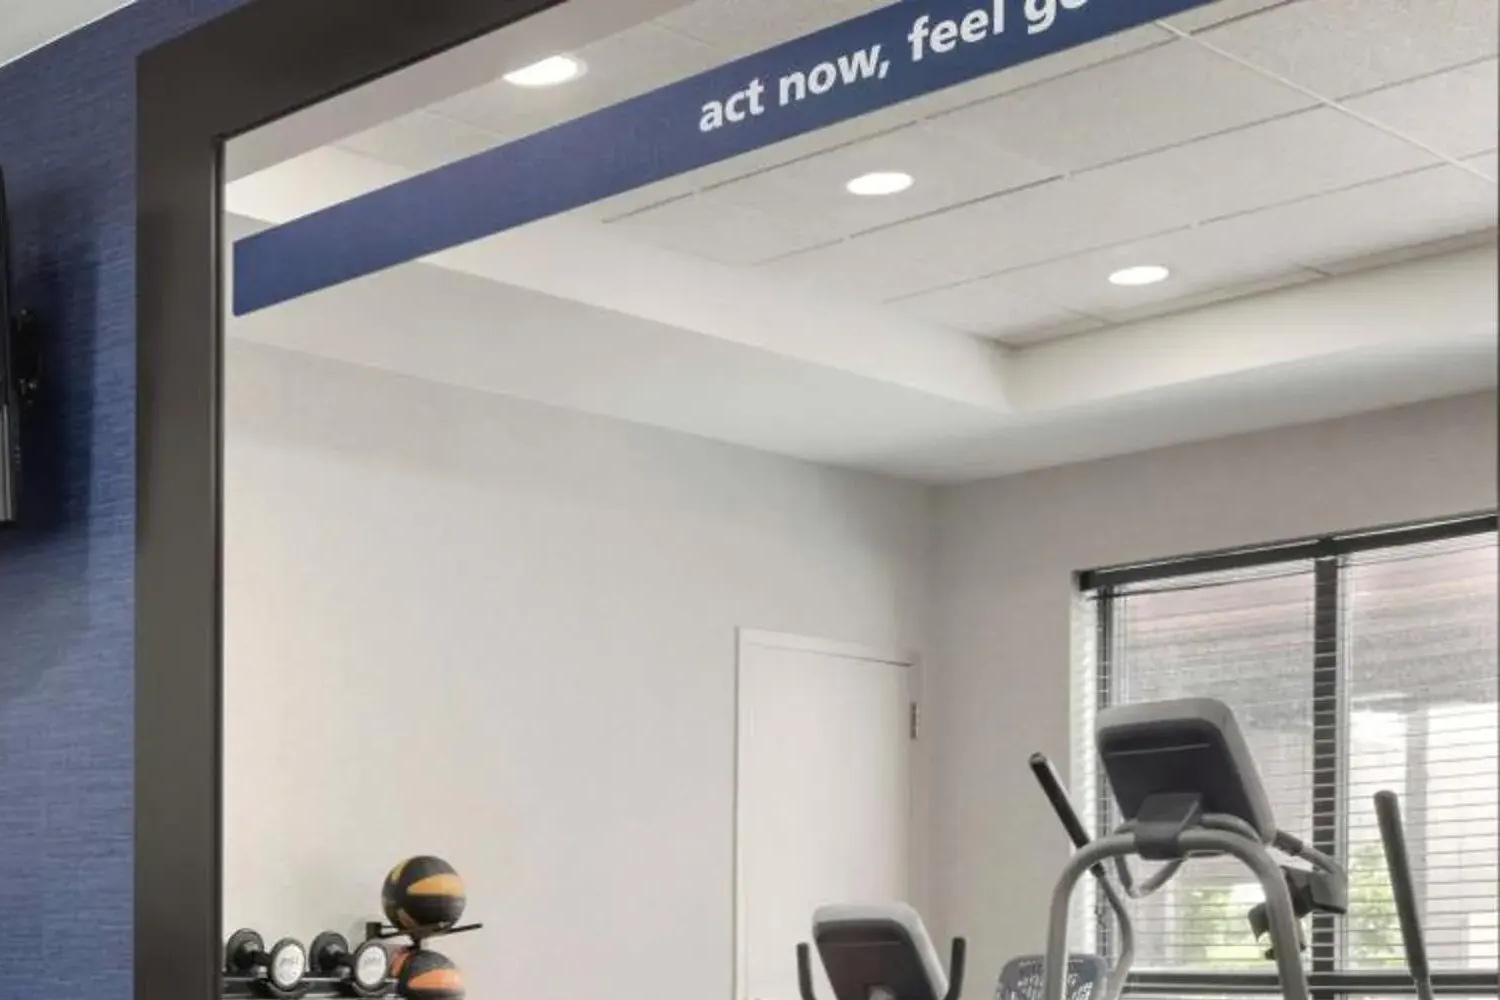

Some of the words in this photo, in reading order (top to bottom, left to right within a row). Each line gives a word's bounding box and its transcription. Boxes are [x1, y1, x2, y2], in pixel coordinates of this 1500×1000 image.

[698, 78, 764, 132] act
[778, 43, 890, 106] now,
[907, 0, 1004, 62] feel
[1024, 0, 1088, 35] g
